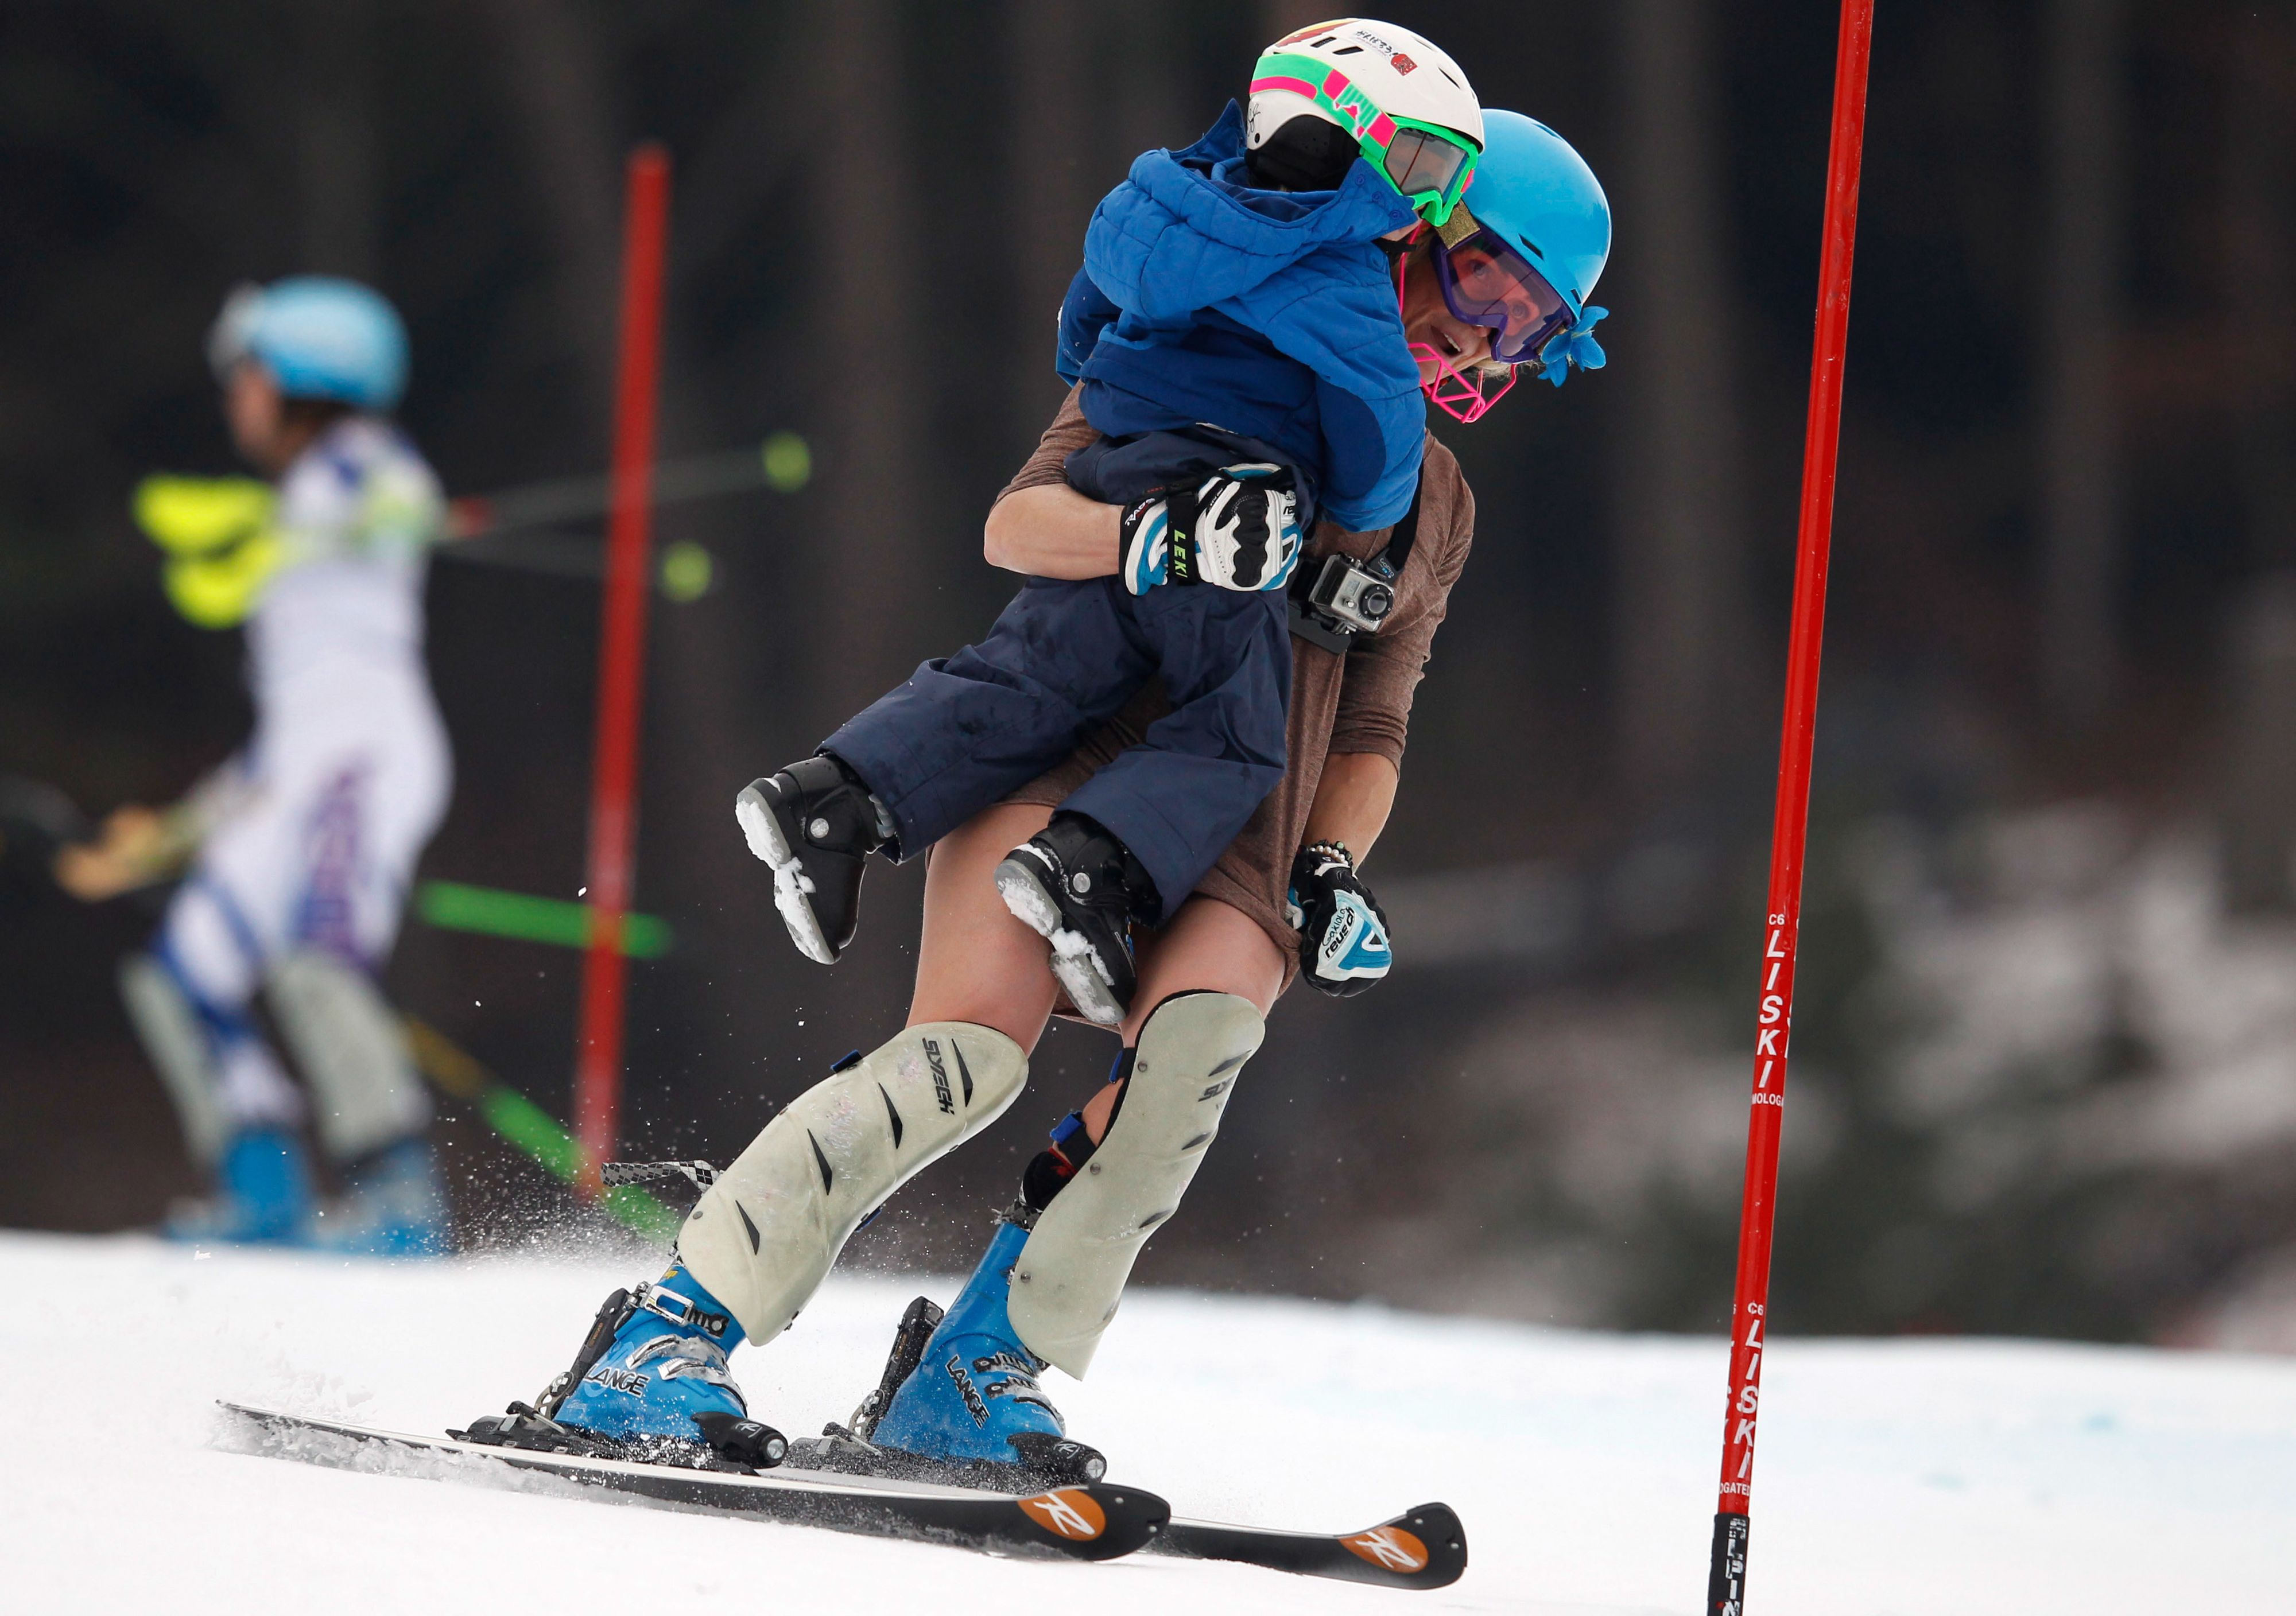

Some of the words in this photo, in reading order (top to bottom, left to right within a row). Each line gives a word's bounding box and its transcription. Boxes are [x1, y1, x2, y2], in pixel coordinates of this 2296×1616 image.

[1174, 529, 1188, 578] LEKI
[1379, 557, 1395, 577] GoPro
[1325, 906, 1355, 959] reusch
[1768, 914, 1785, 925] C6
[1756, 930, 1785, 1088] LISKI
[922, 1037, 955, 1115] SLYTECH
[1747, 1302, 1764, 1316] C6
[583, 1364, 651, 1399] LANGE
[945, 1354, 991, 1429] LANGE
[1733, 1319, 1762, 1479] LISKI
